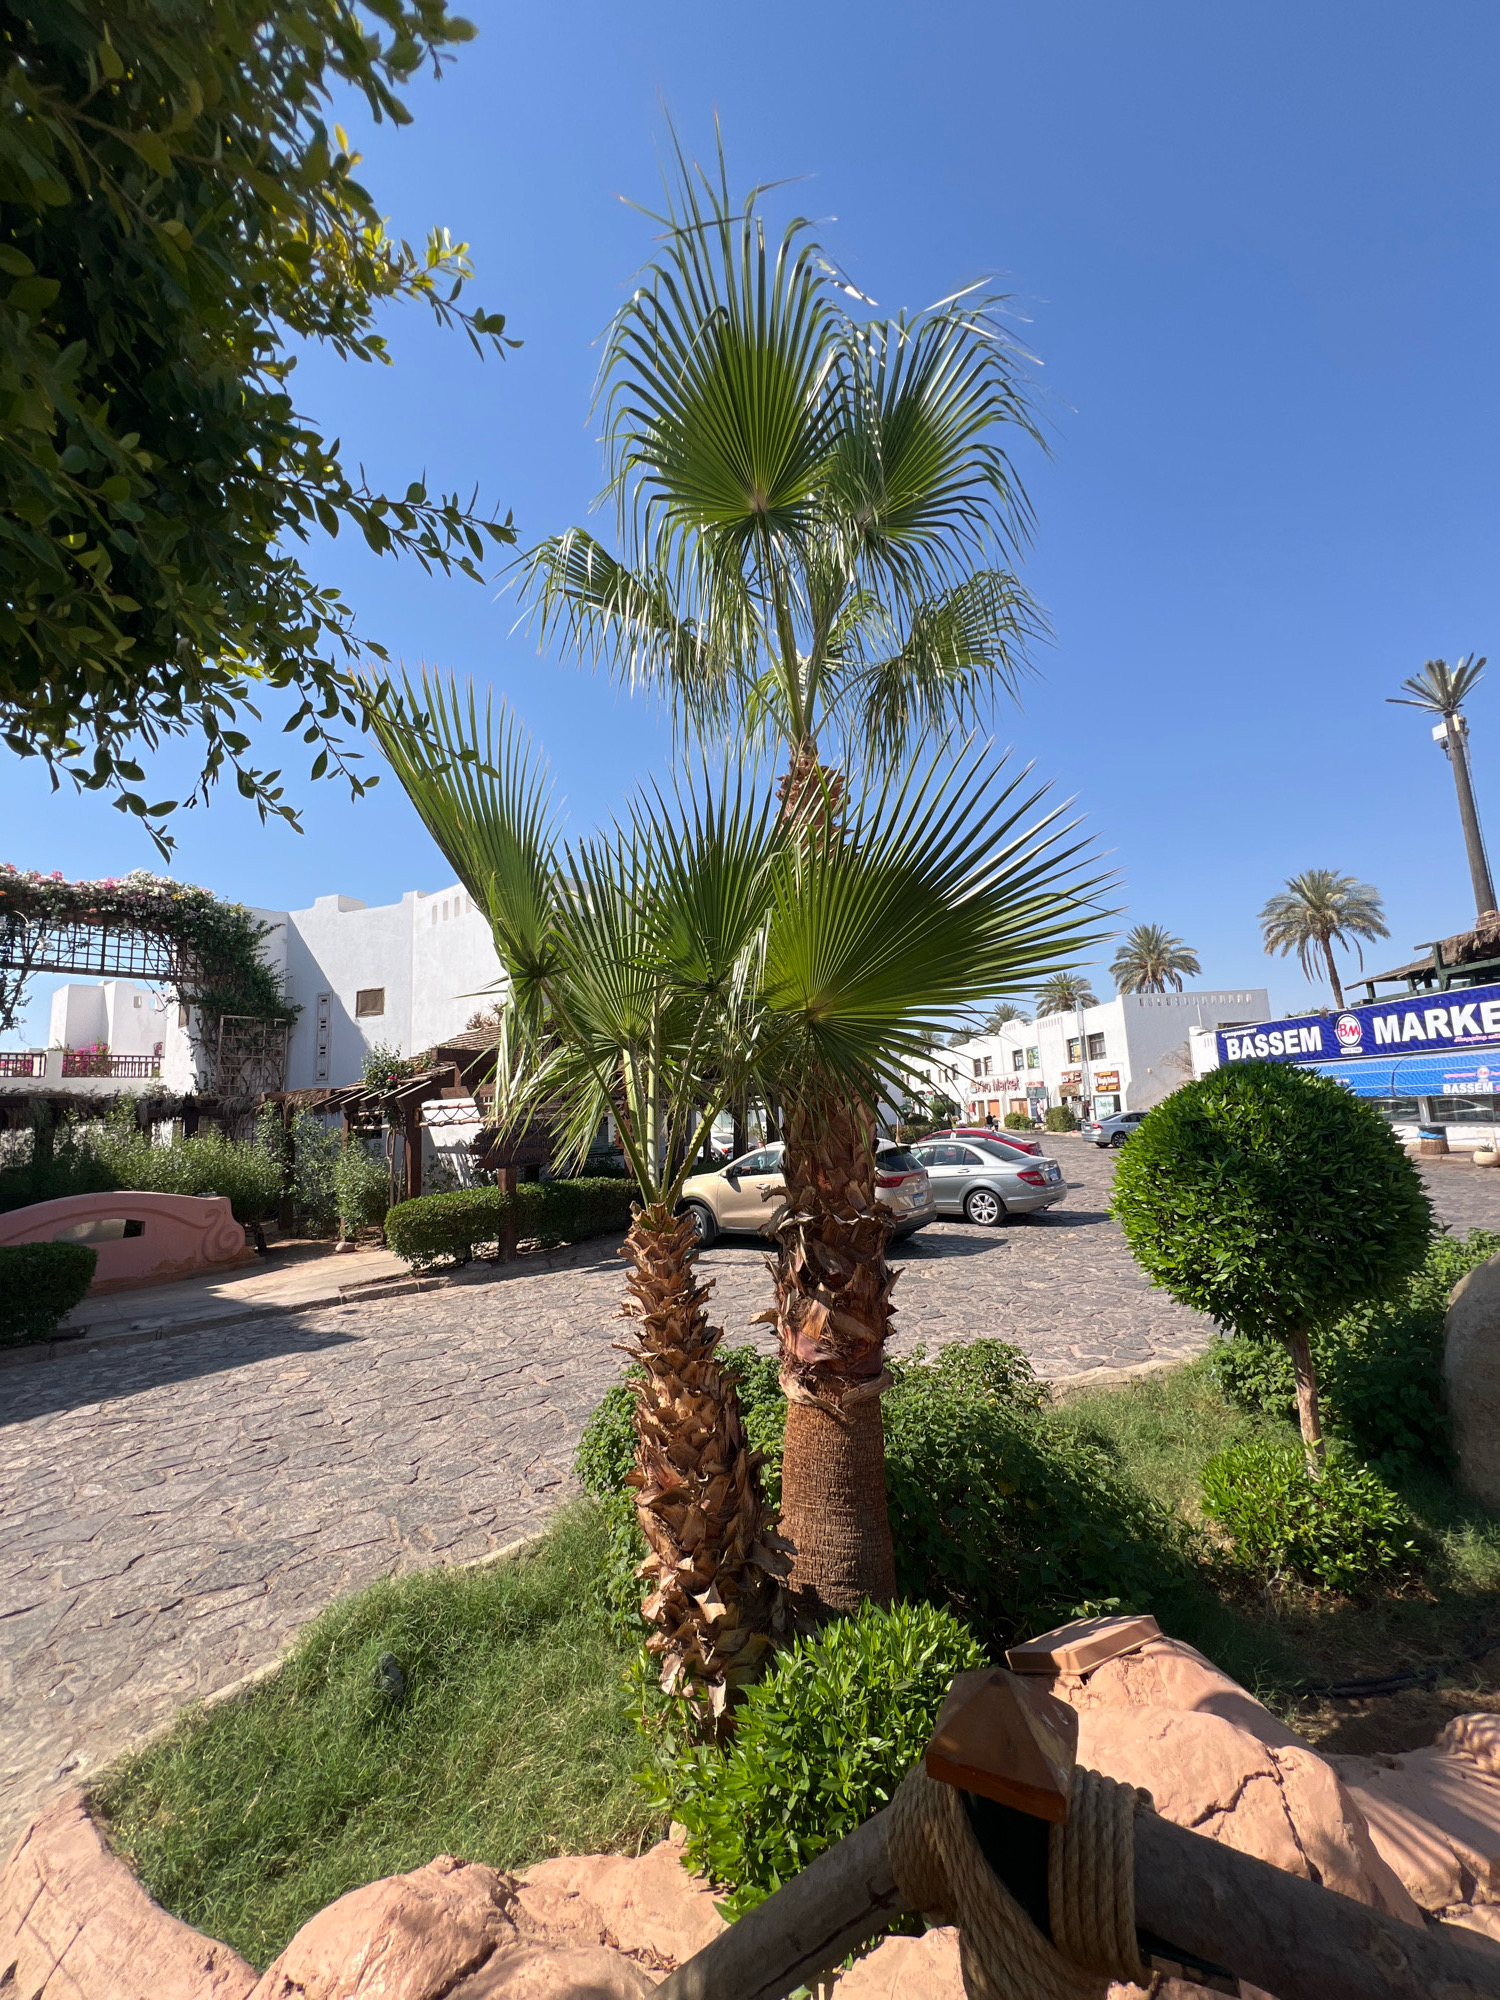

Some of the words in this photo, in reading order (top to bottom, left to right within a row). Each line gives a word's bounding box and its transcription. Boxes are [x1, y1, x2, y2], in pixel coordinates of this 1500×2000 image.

[1372, 1000, 1500, 1045] MARKE
[1226, 1026, 1322, 1060] BASSEM
[1442, 1082, 1494, 1094] BASSEM
